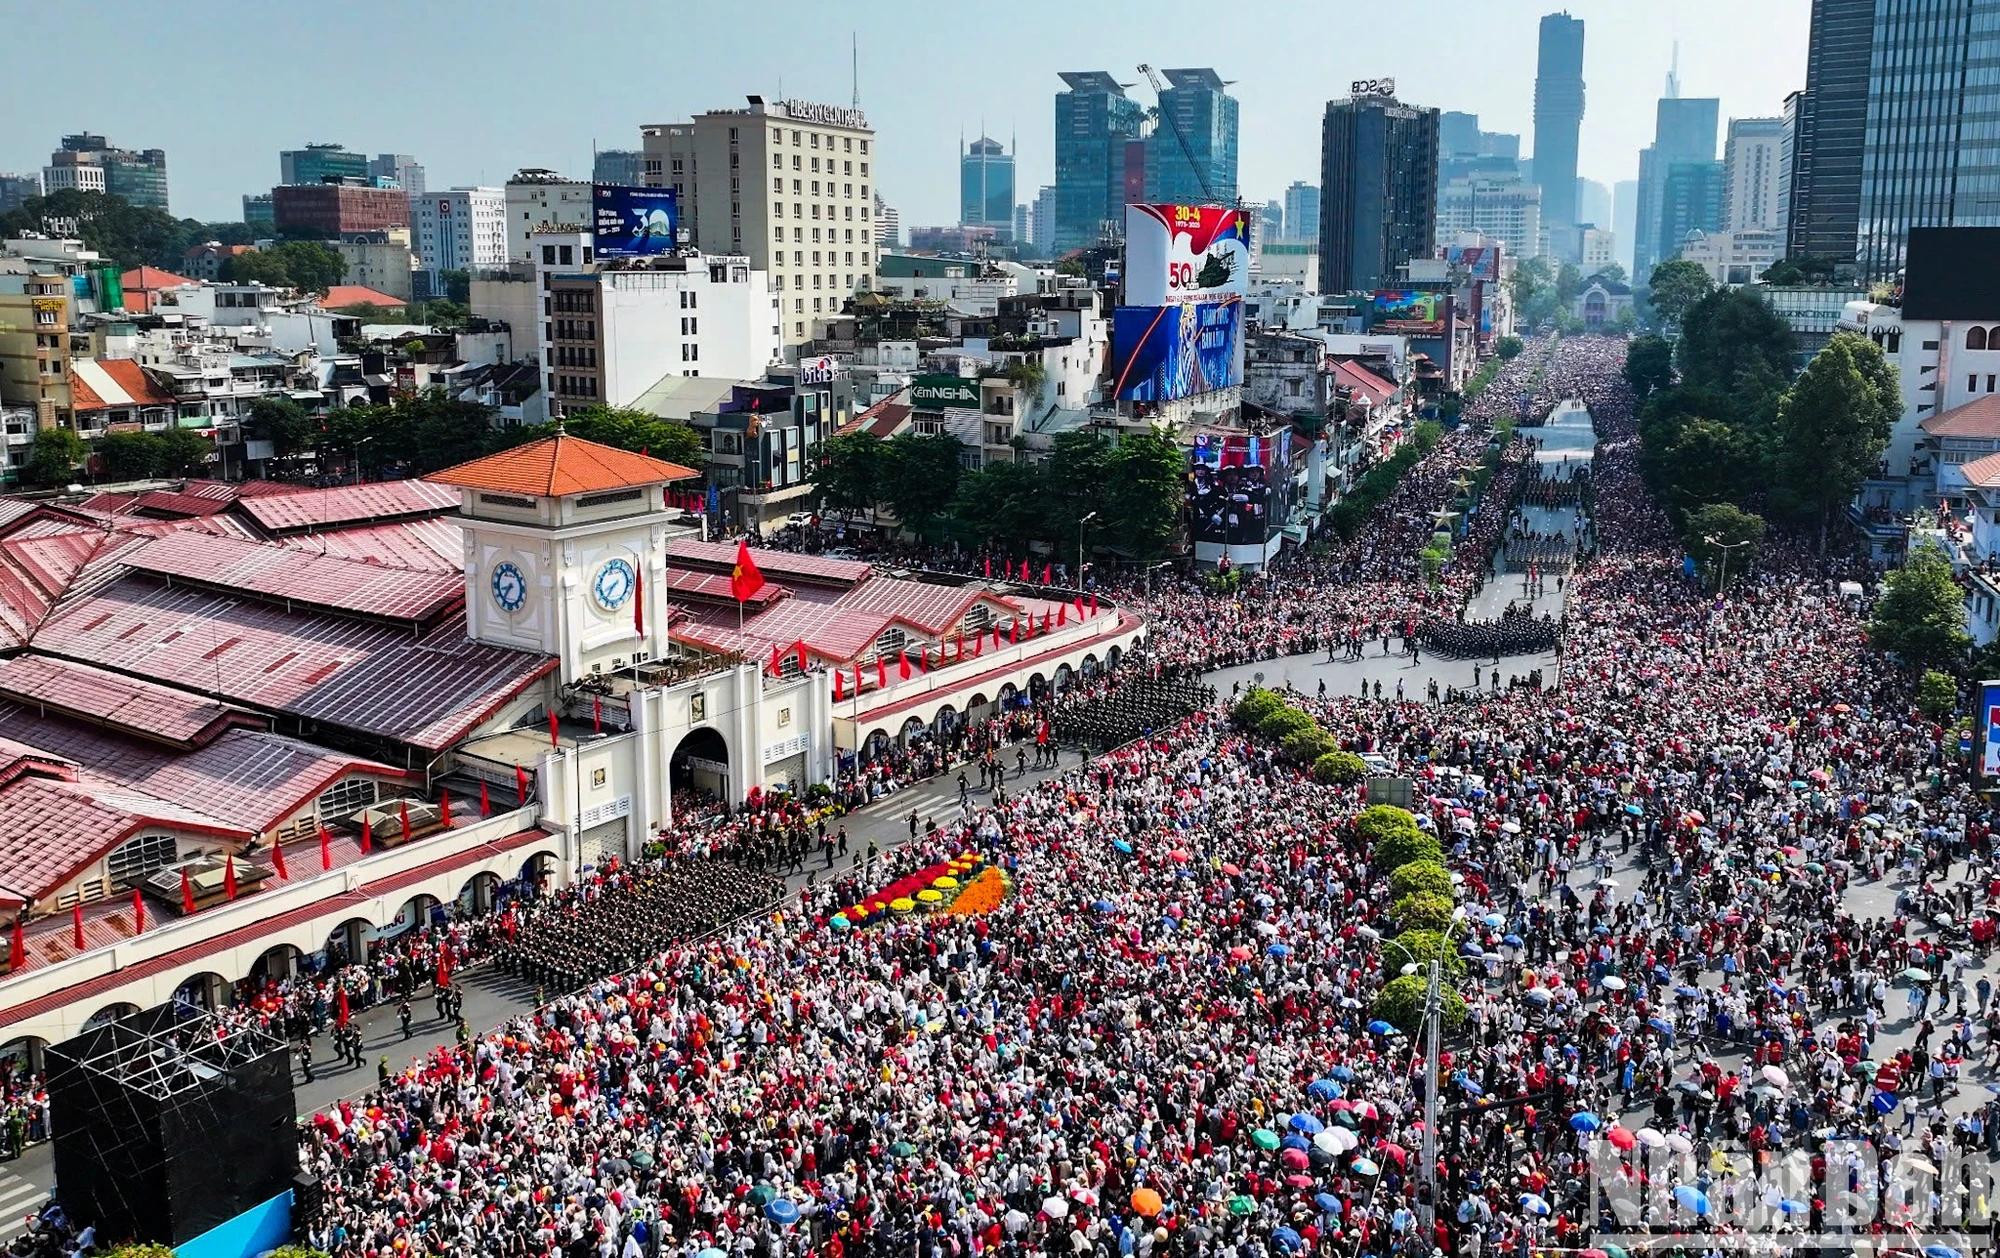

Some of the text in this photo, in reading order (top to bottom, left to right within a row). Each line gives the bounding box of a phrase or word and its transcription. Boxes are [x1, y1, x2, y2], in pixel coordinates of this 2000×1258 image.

[790, 98, 823, 121] LIBERTY
[1175, 205, 1201, 221] 30-4
[1169, 262, 1192, 289] 50
